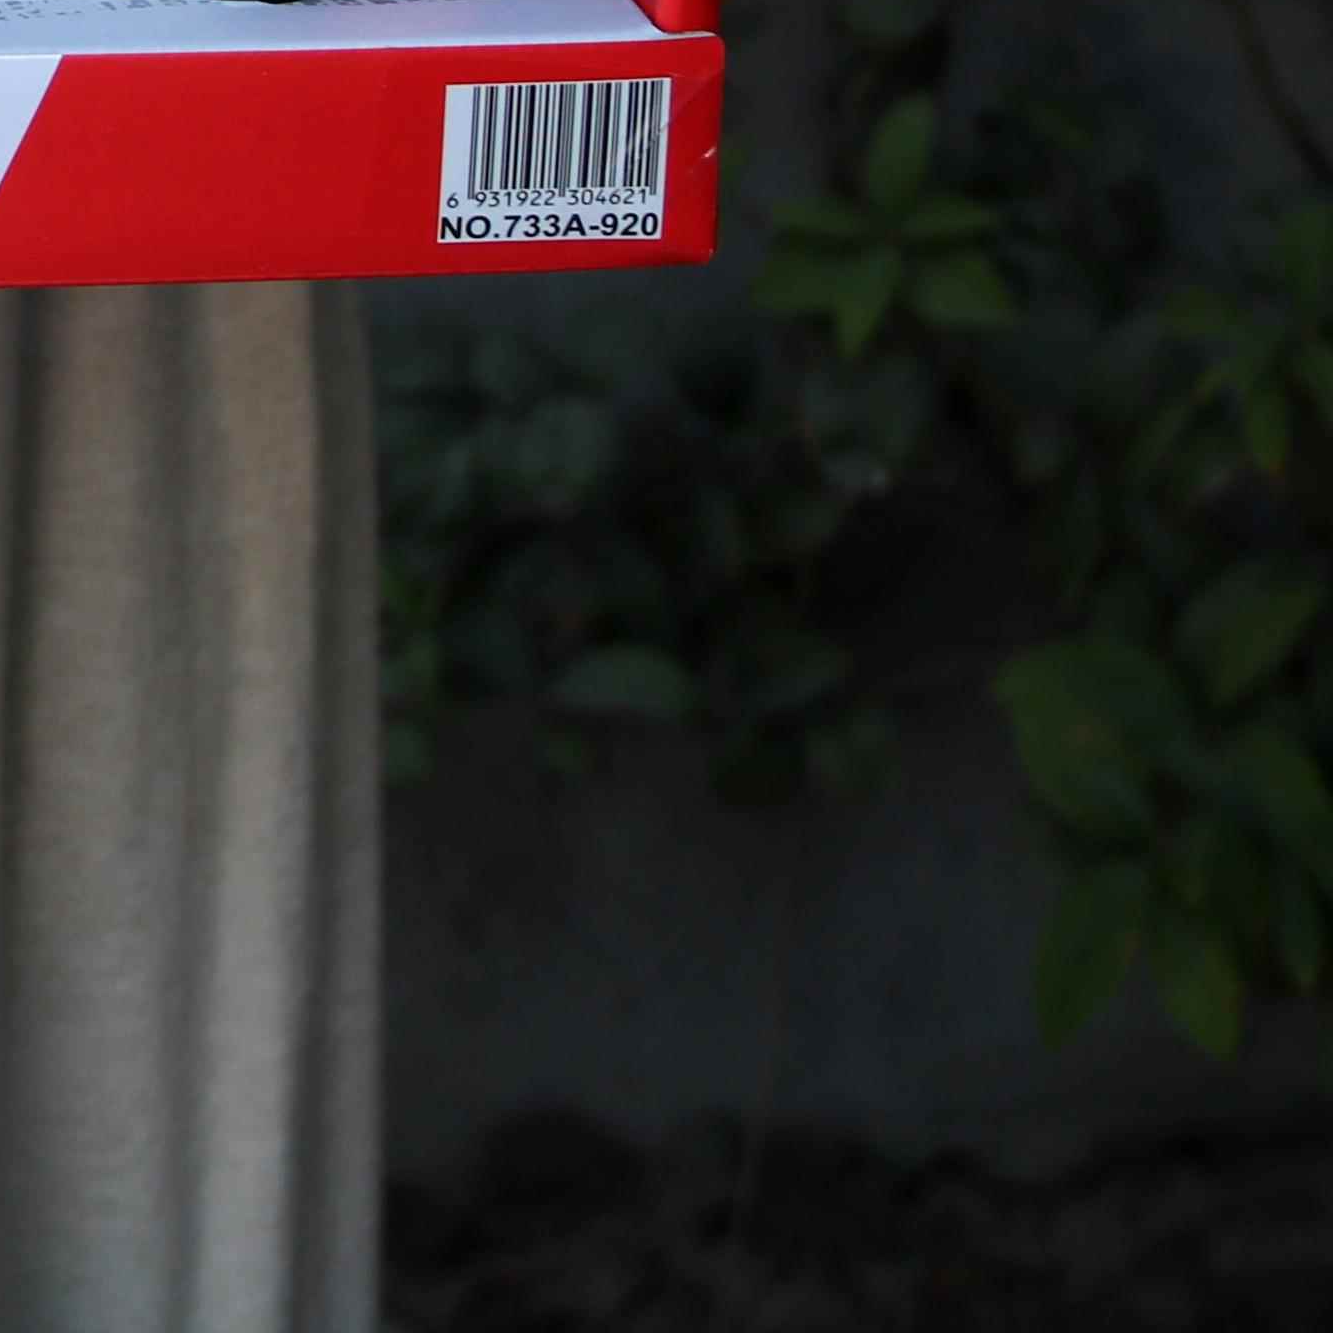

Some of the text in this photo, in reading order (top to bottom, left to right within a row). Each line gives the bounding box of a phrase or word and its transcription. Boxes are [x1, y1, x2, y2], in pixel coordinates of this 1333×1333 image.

[446, 188, 648, 209] 6 931922 304621
[439, 212, 659, 240] NO.733A-920
